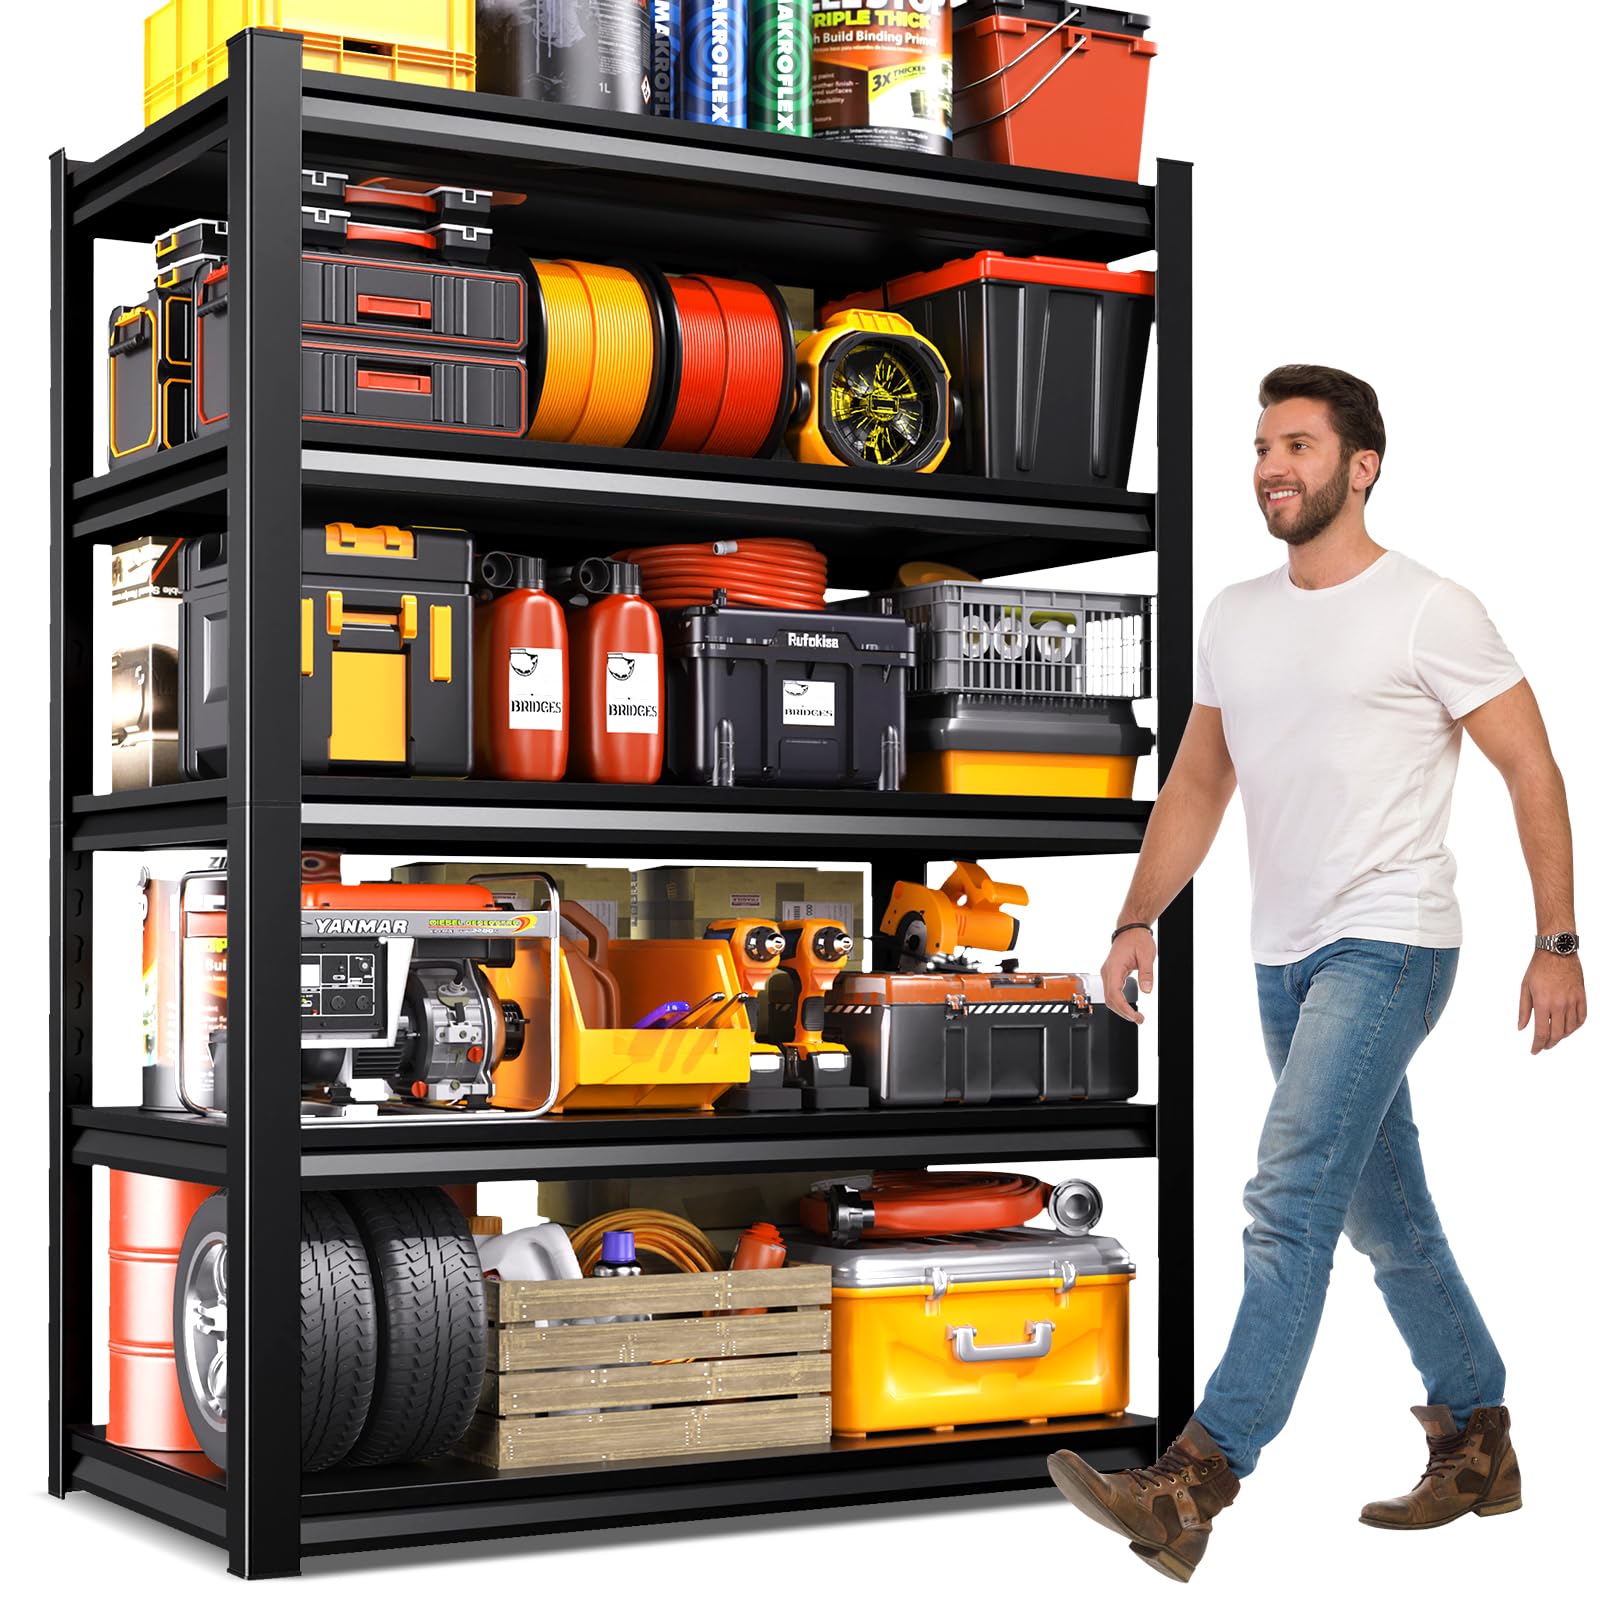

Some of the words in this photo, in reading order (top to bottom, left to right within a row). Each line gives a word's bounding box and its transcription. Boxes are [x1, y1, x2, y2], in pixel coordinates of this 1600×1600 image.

[874, 9, 931, 30] THICK
[823, 30, 853, 43] Build
[856, 29, 903, 45] Binding
[777, 0, 795, 131] AKROFLEX
[599, 82, 612, 94] 1L
[872, 72, 891, 92] 3X
[788, 632, 839, 649] Rufokisa
[511, 700, 562, 714] BRIDGES
[608, 704, 658, 717] BRIDGES
[315, 918, 408, 934] YANMAR
